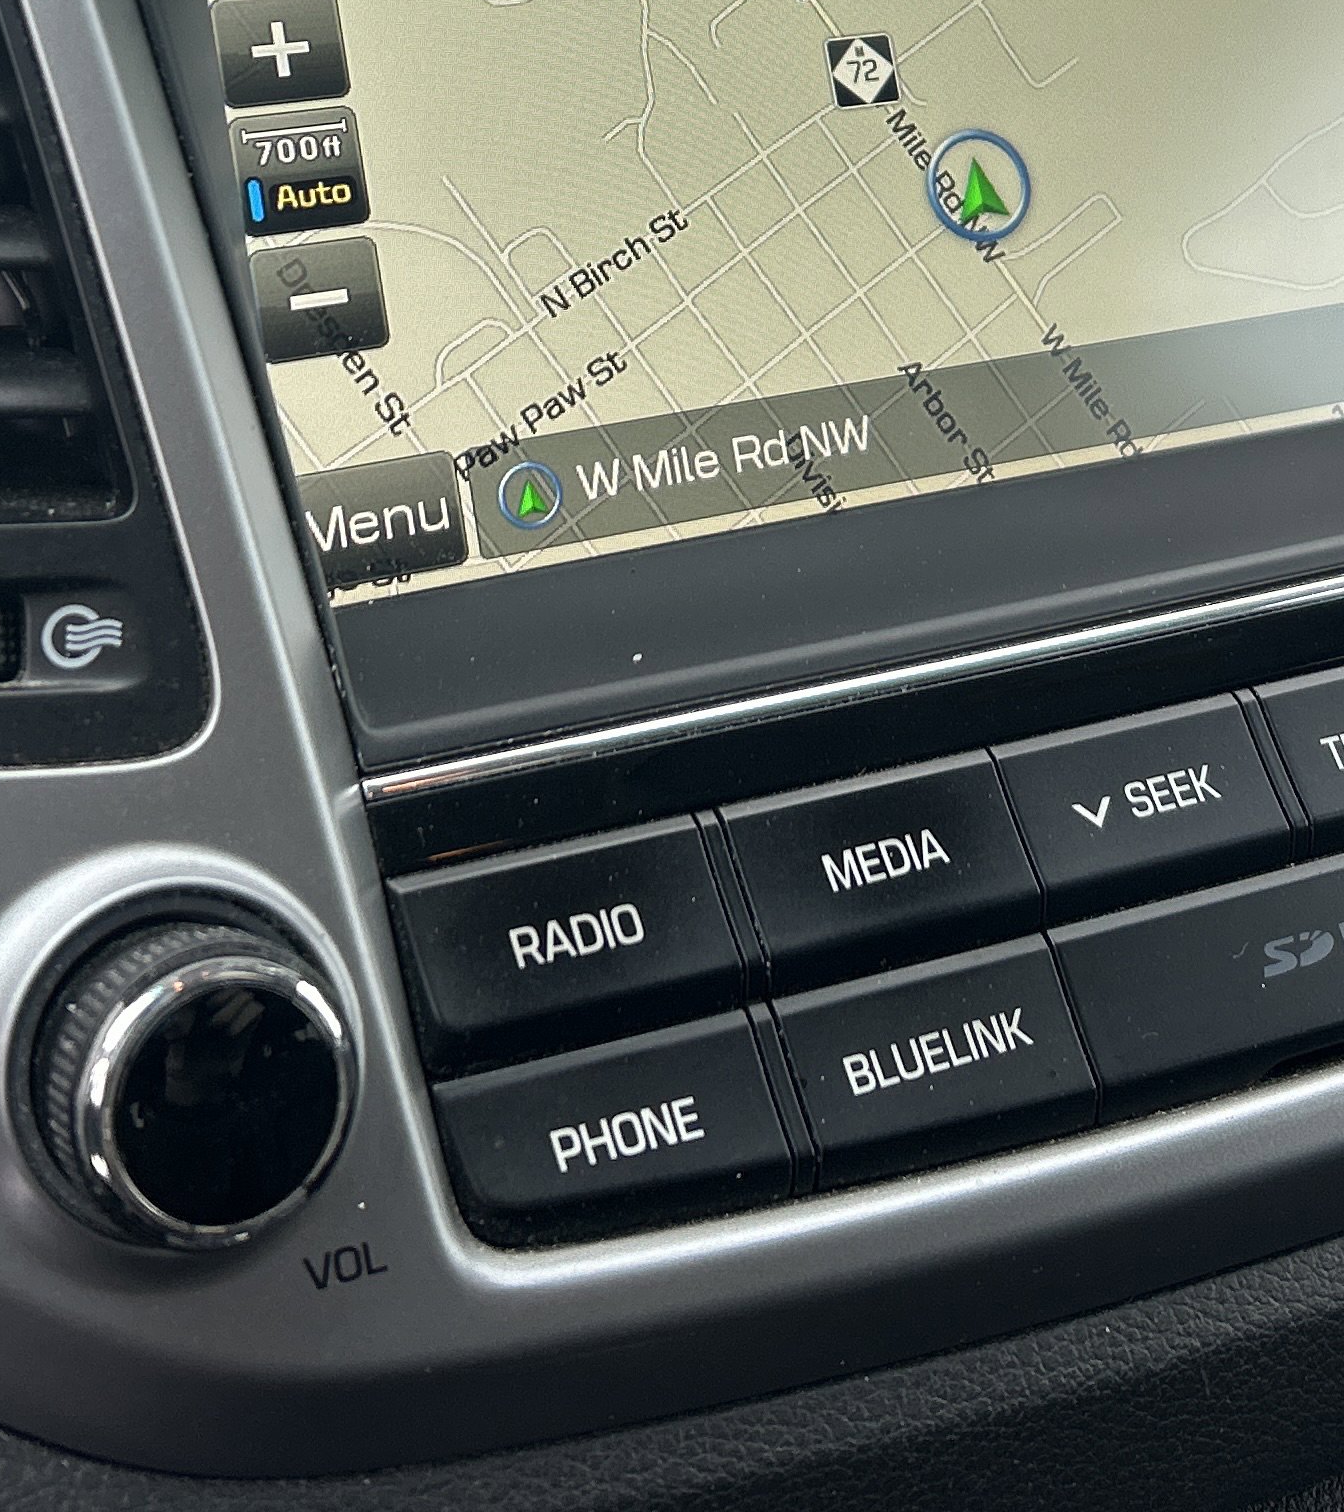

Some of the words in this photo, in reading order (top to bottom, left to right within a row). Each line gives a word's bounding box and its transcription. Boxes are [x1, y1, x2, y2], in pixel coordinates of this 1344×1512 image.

[845, 58, 880, 84] 72
[885, 108, 933, 172] Mile
[277, 181, 353, 211] Auto
[539, 284, 572, 319] N
[568, 234, 652, 299] Birch
[648, 208, 689, 243] St
[1040, 322, 1073, 357] W
[1062, 356, 1110, 421] Mile
[374, 392, 412, 437] St
[453, 424, 521, 482] Paw
[519, 377, 587, 434] Paw
[586, 351, 628, 387] St
[896, 361, 968, 446] Arbor
[963, 446, 996, 484] St
[575, 457, 620, 501] W
[631, 445, 721, 492] Mile
[731, 427, 791, 474] Rd
[799, 414, 870, 461] NW
[305, 495, 451, 553] Menu
[1123, 763, 1222, 819] SEEK
[820, 828, 950, 893] MEDIA
[508, 902, 645, 970] RADIO
[841, 1007, 1034, 1096] BLUELINK
[549, 1095, 706, 1174] PHONE
[302, 1240, 388, 1291] VOL
